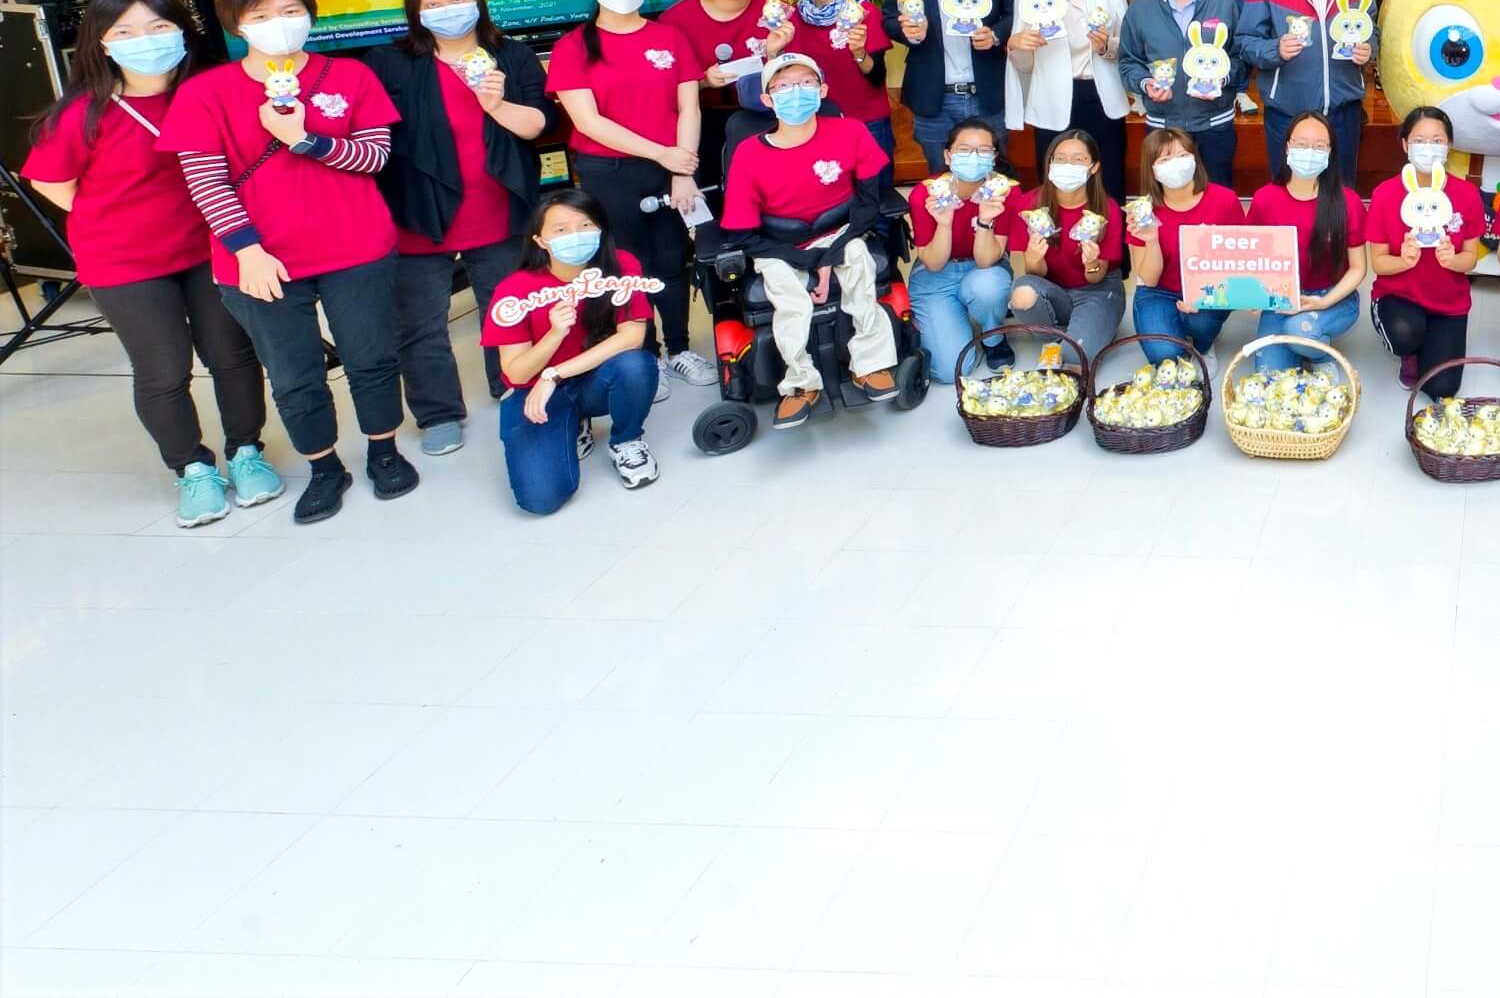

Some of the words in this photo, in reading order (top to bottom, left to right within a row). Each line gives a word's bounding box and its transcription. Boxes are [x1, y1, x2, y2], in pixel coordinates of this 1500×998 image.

[1211, 234, 1259, 250] Peer
[1187, 257, 1291, 272] Counsellor
[494, 285, 577, 324] Caring
[577, 269, 663, 305] League
